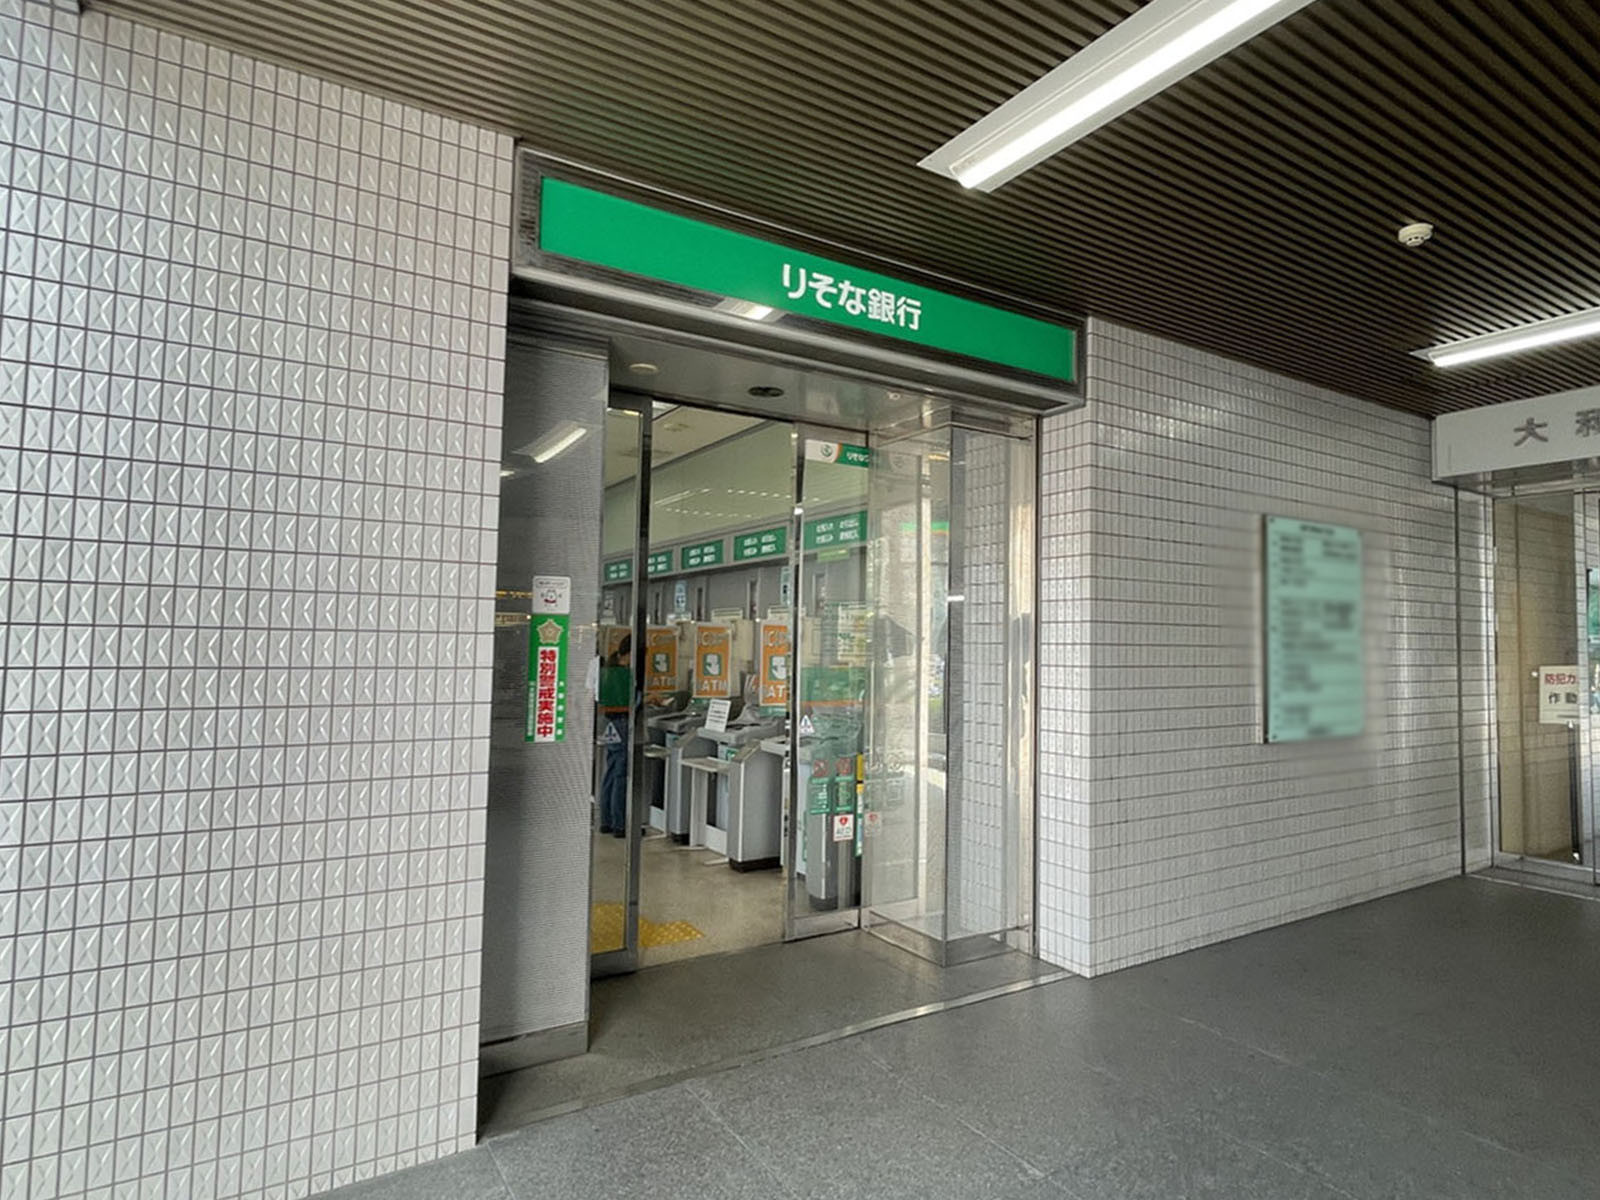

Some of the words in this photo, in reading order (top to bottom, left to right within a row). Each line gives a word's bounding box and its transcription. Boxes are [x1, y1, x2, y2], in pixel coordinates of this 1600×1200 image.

[782, 264, 922, 330] りそな銀行
[537, 649, 556, 738] 特別警戒実施中
[768, 684, 786, 699] AT
[1545, 673, 1577, 685] 防犯カ
